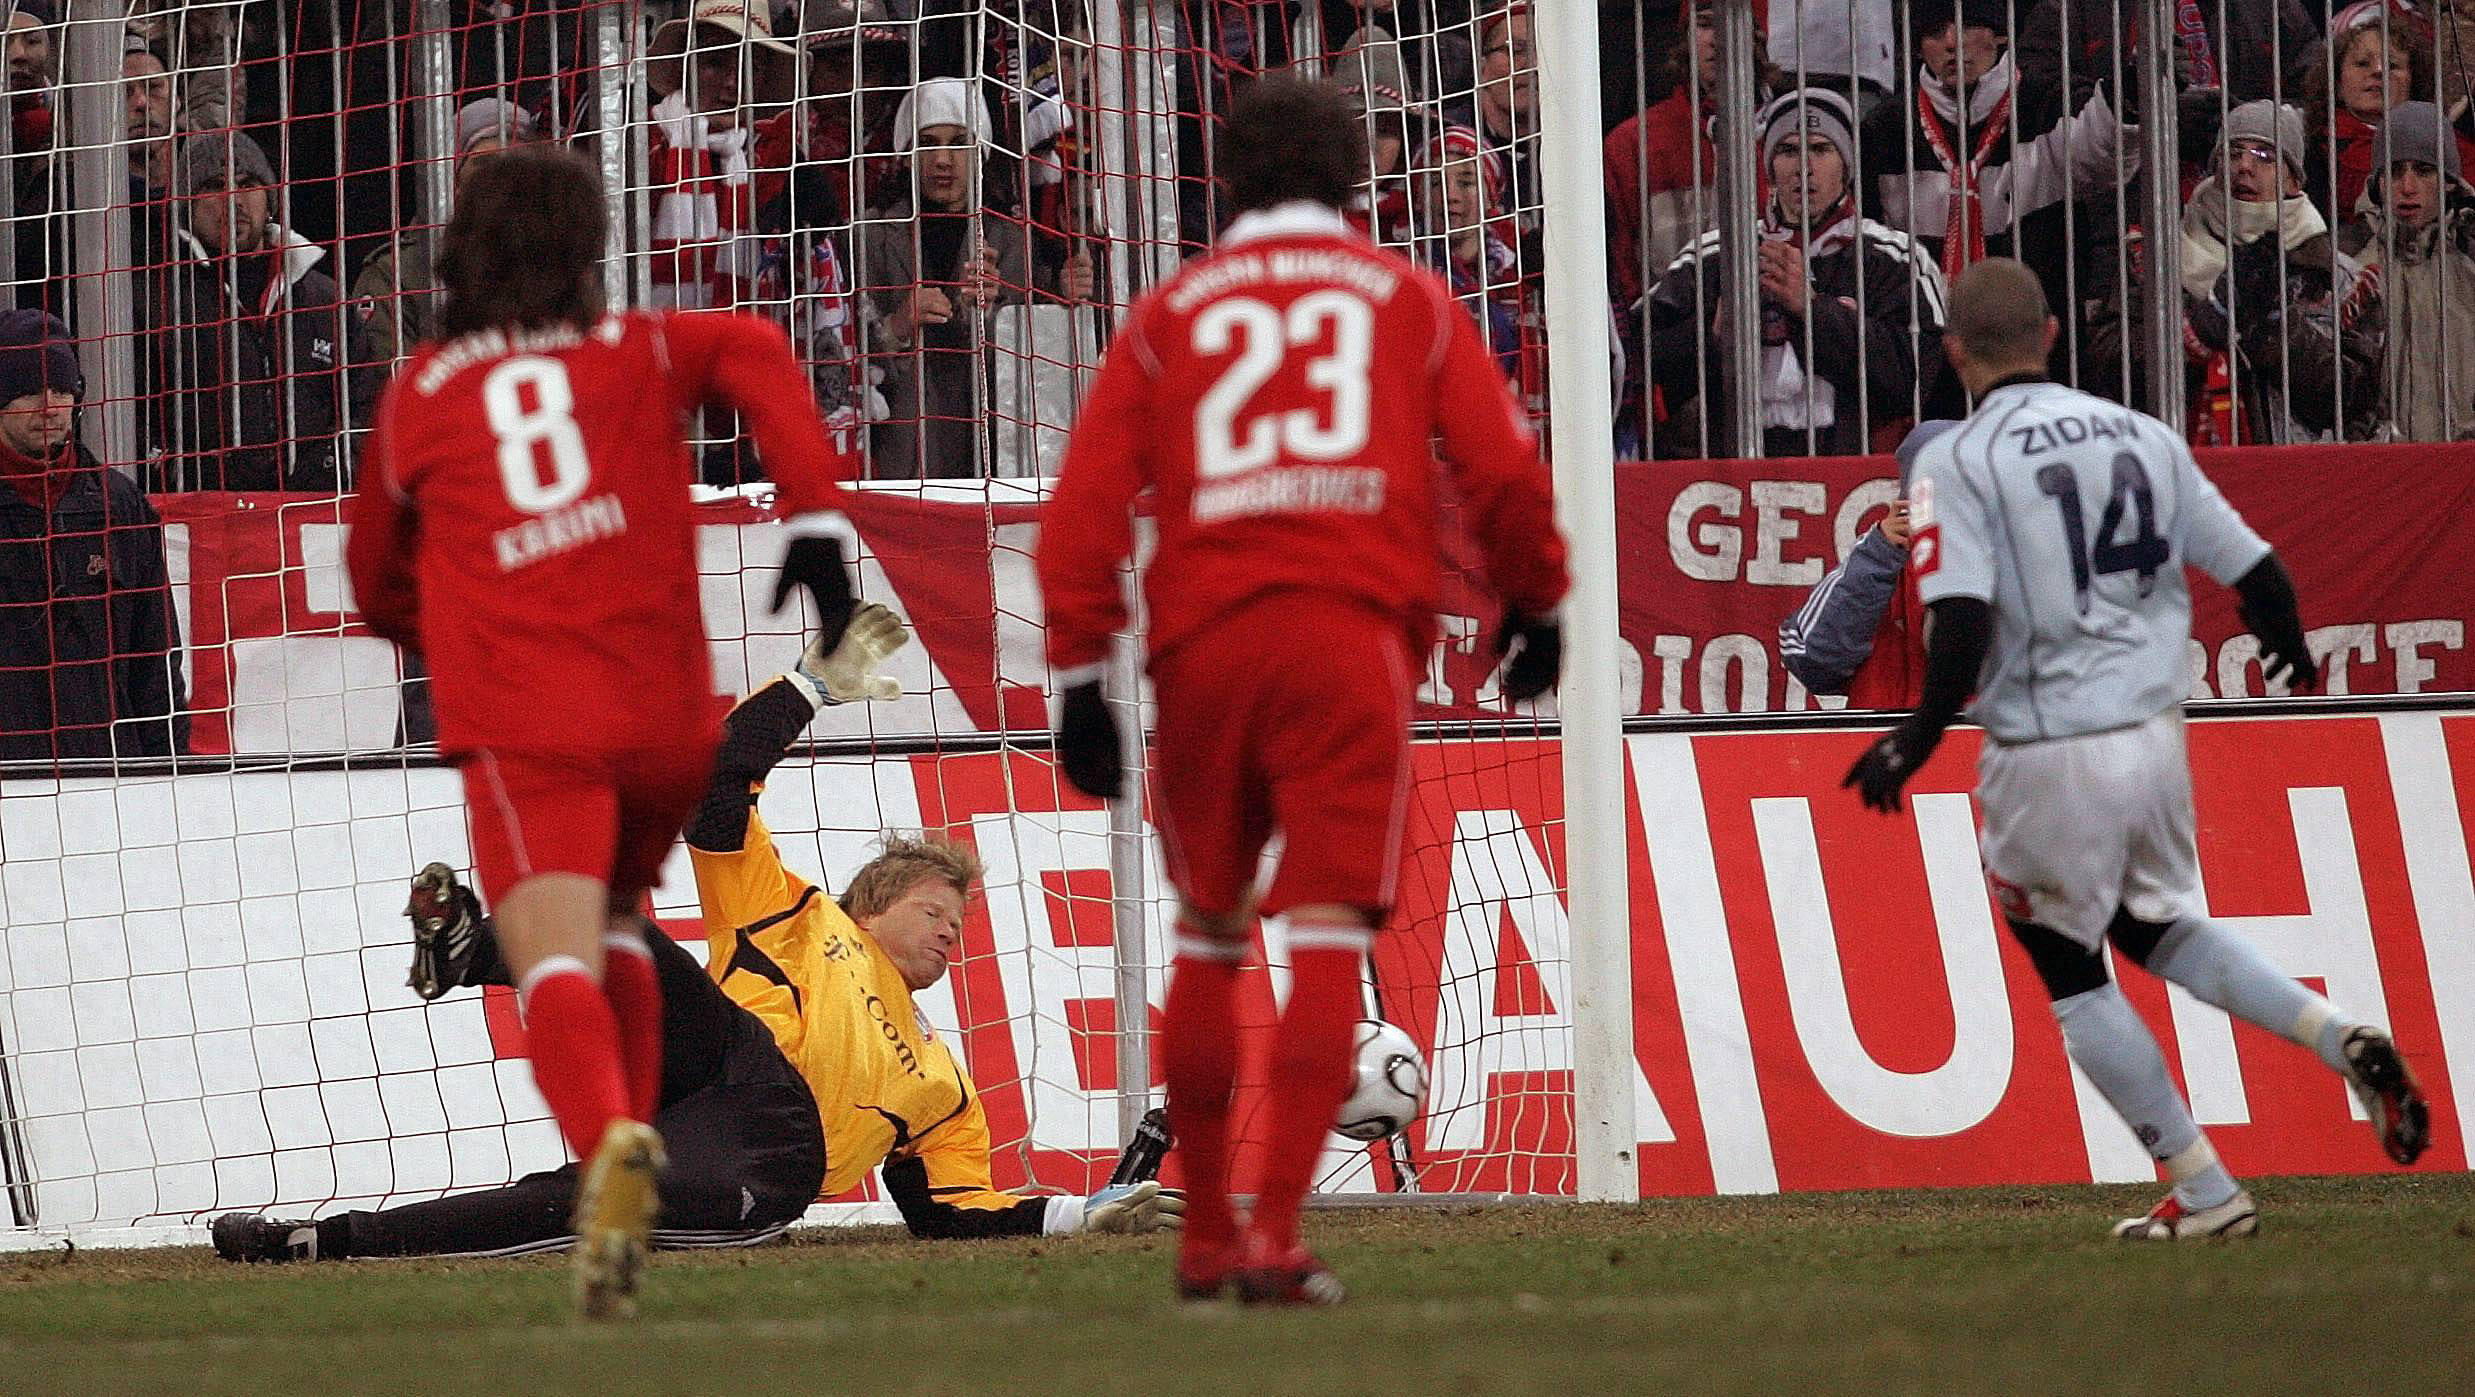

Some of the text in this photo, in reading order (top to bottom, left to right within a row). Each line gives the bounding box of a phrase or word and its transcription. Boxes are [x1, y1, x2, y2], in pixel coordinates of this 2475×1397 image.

[484, 354, 592, 513] 8
[1191, 287, 1375, 478] 23
[2009, 405, 2141, 456] ZIDAN
[2035, 451, 2171, 616] 14
